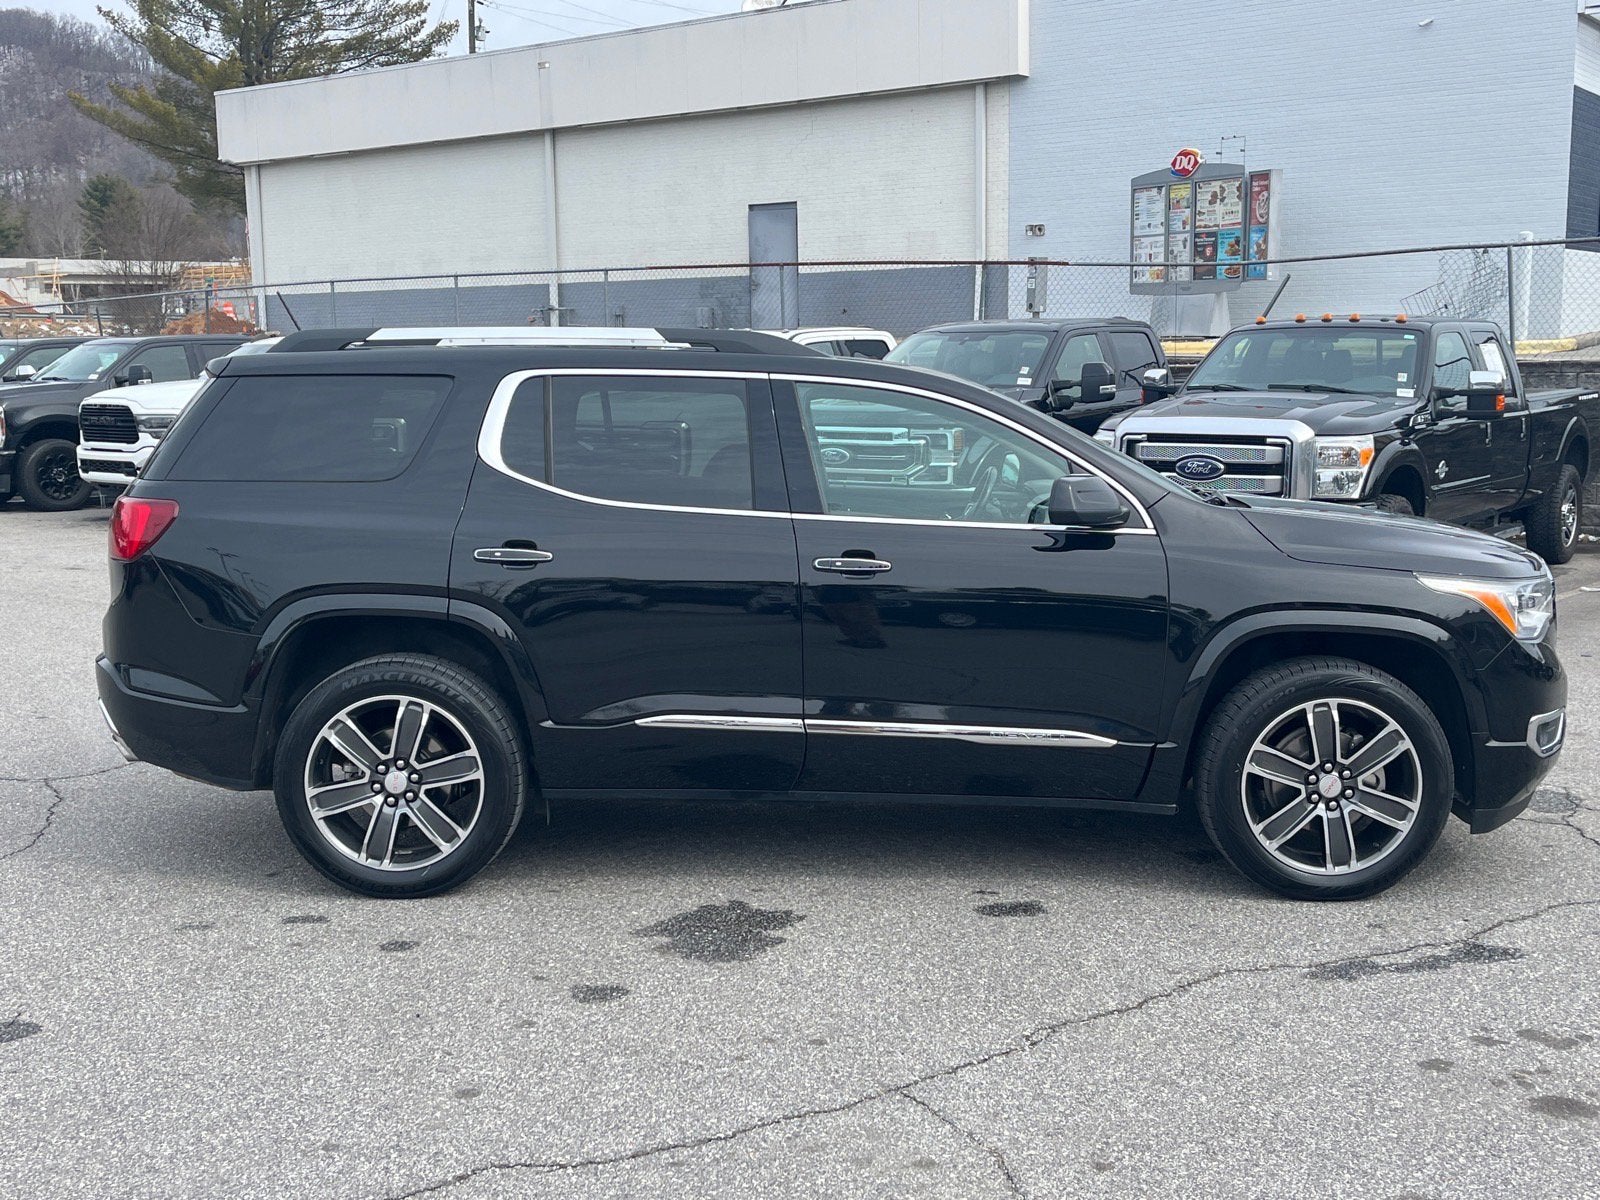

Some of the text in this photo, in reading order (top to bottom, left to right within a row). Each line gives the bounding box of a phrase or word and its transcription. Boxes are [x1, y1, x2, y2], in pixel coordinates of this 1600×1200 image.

[1175, 155, 1195, 171] DQ
[1184, 461, 1212, 474] Ford
[341, 671, 471, 704] MAXCLIMATE
[989, 731, 1065, 741] DENALI
